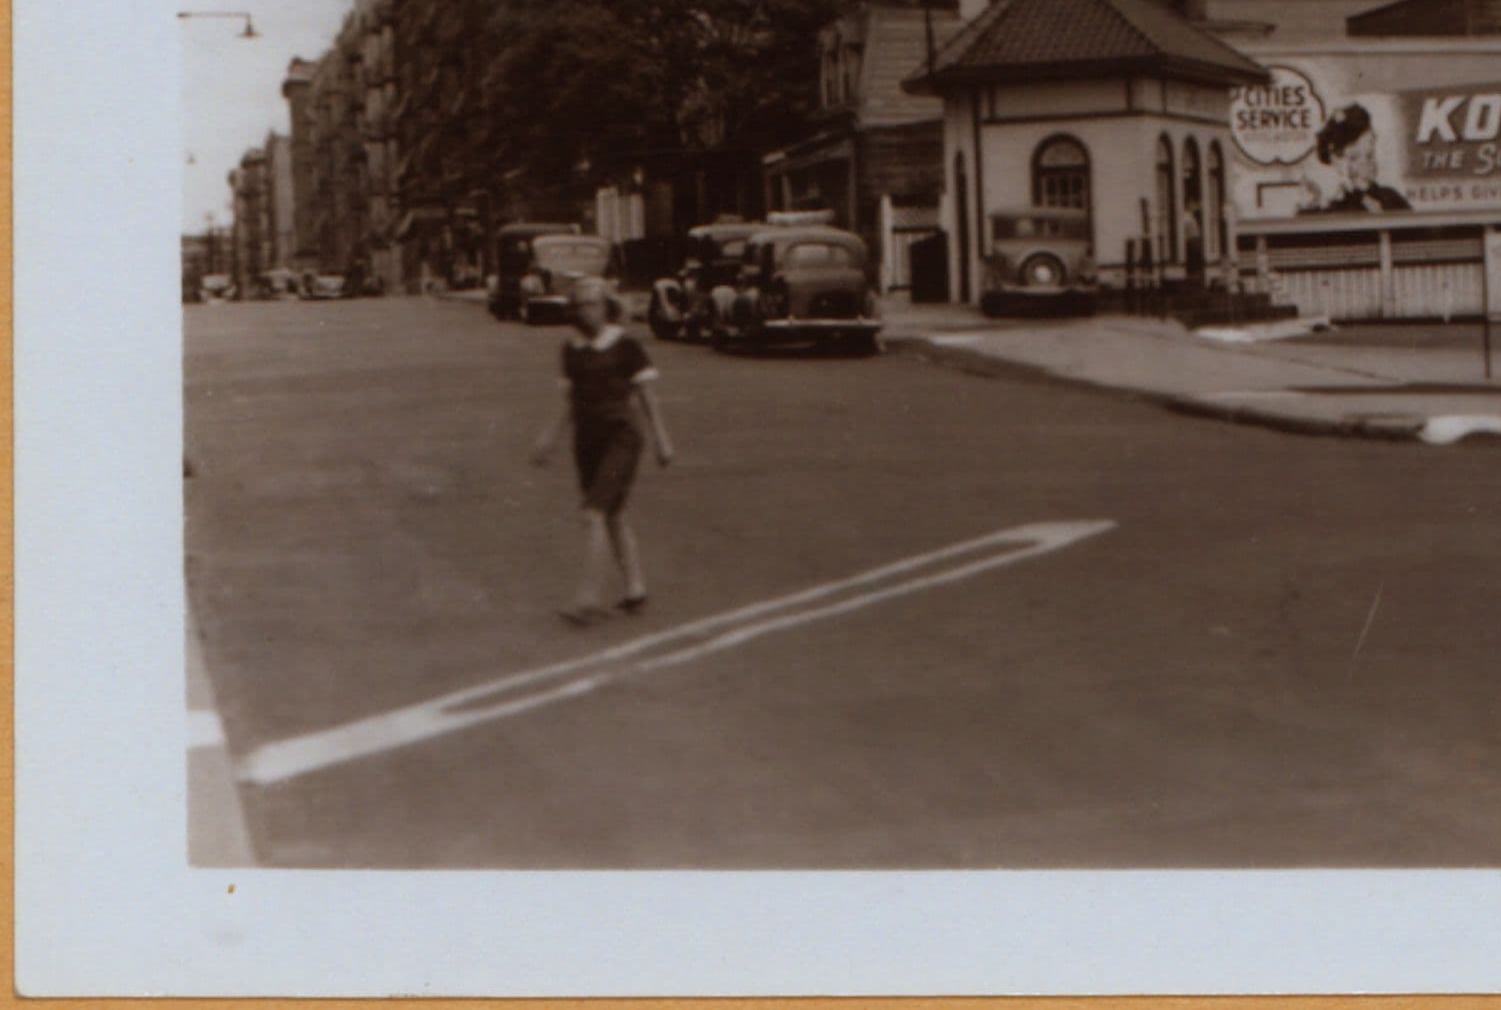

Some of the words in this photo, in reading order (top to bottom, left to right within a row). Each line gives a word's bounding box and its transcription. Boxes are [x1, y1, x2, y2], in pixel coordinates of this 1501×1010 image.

[1245, 85, 1306, 107] CITIES
[1236, 108, 1312, 130] SERVICE
[1422, 149, 1465, 168] THE
[1405, 184, 1463, 201] HELPS
